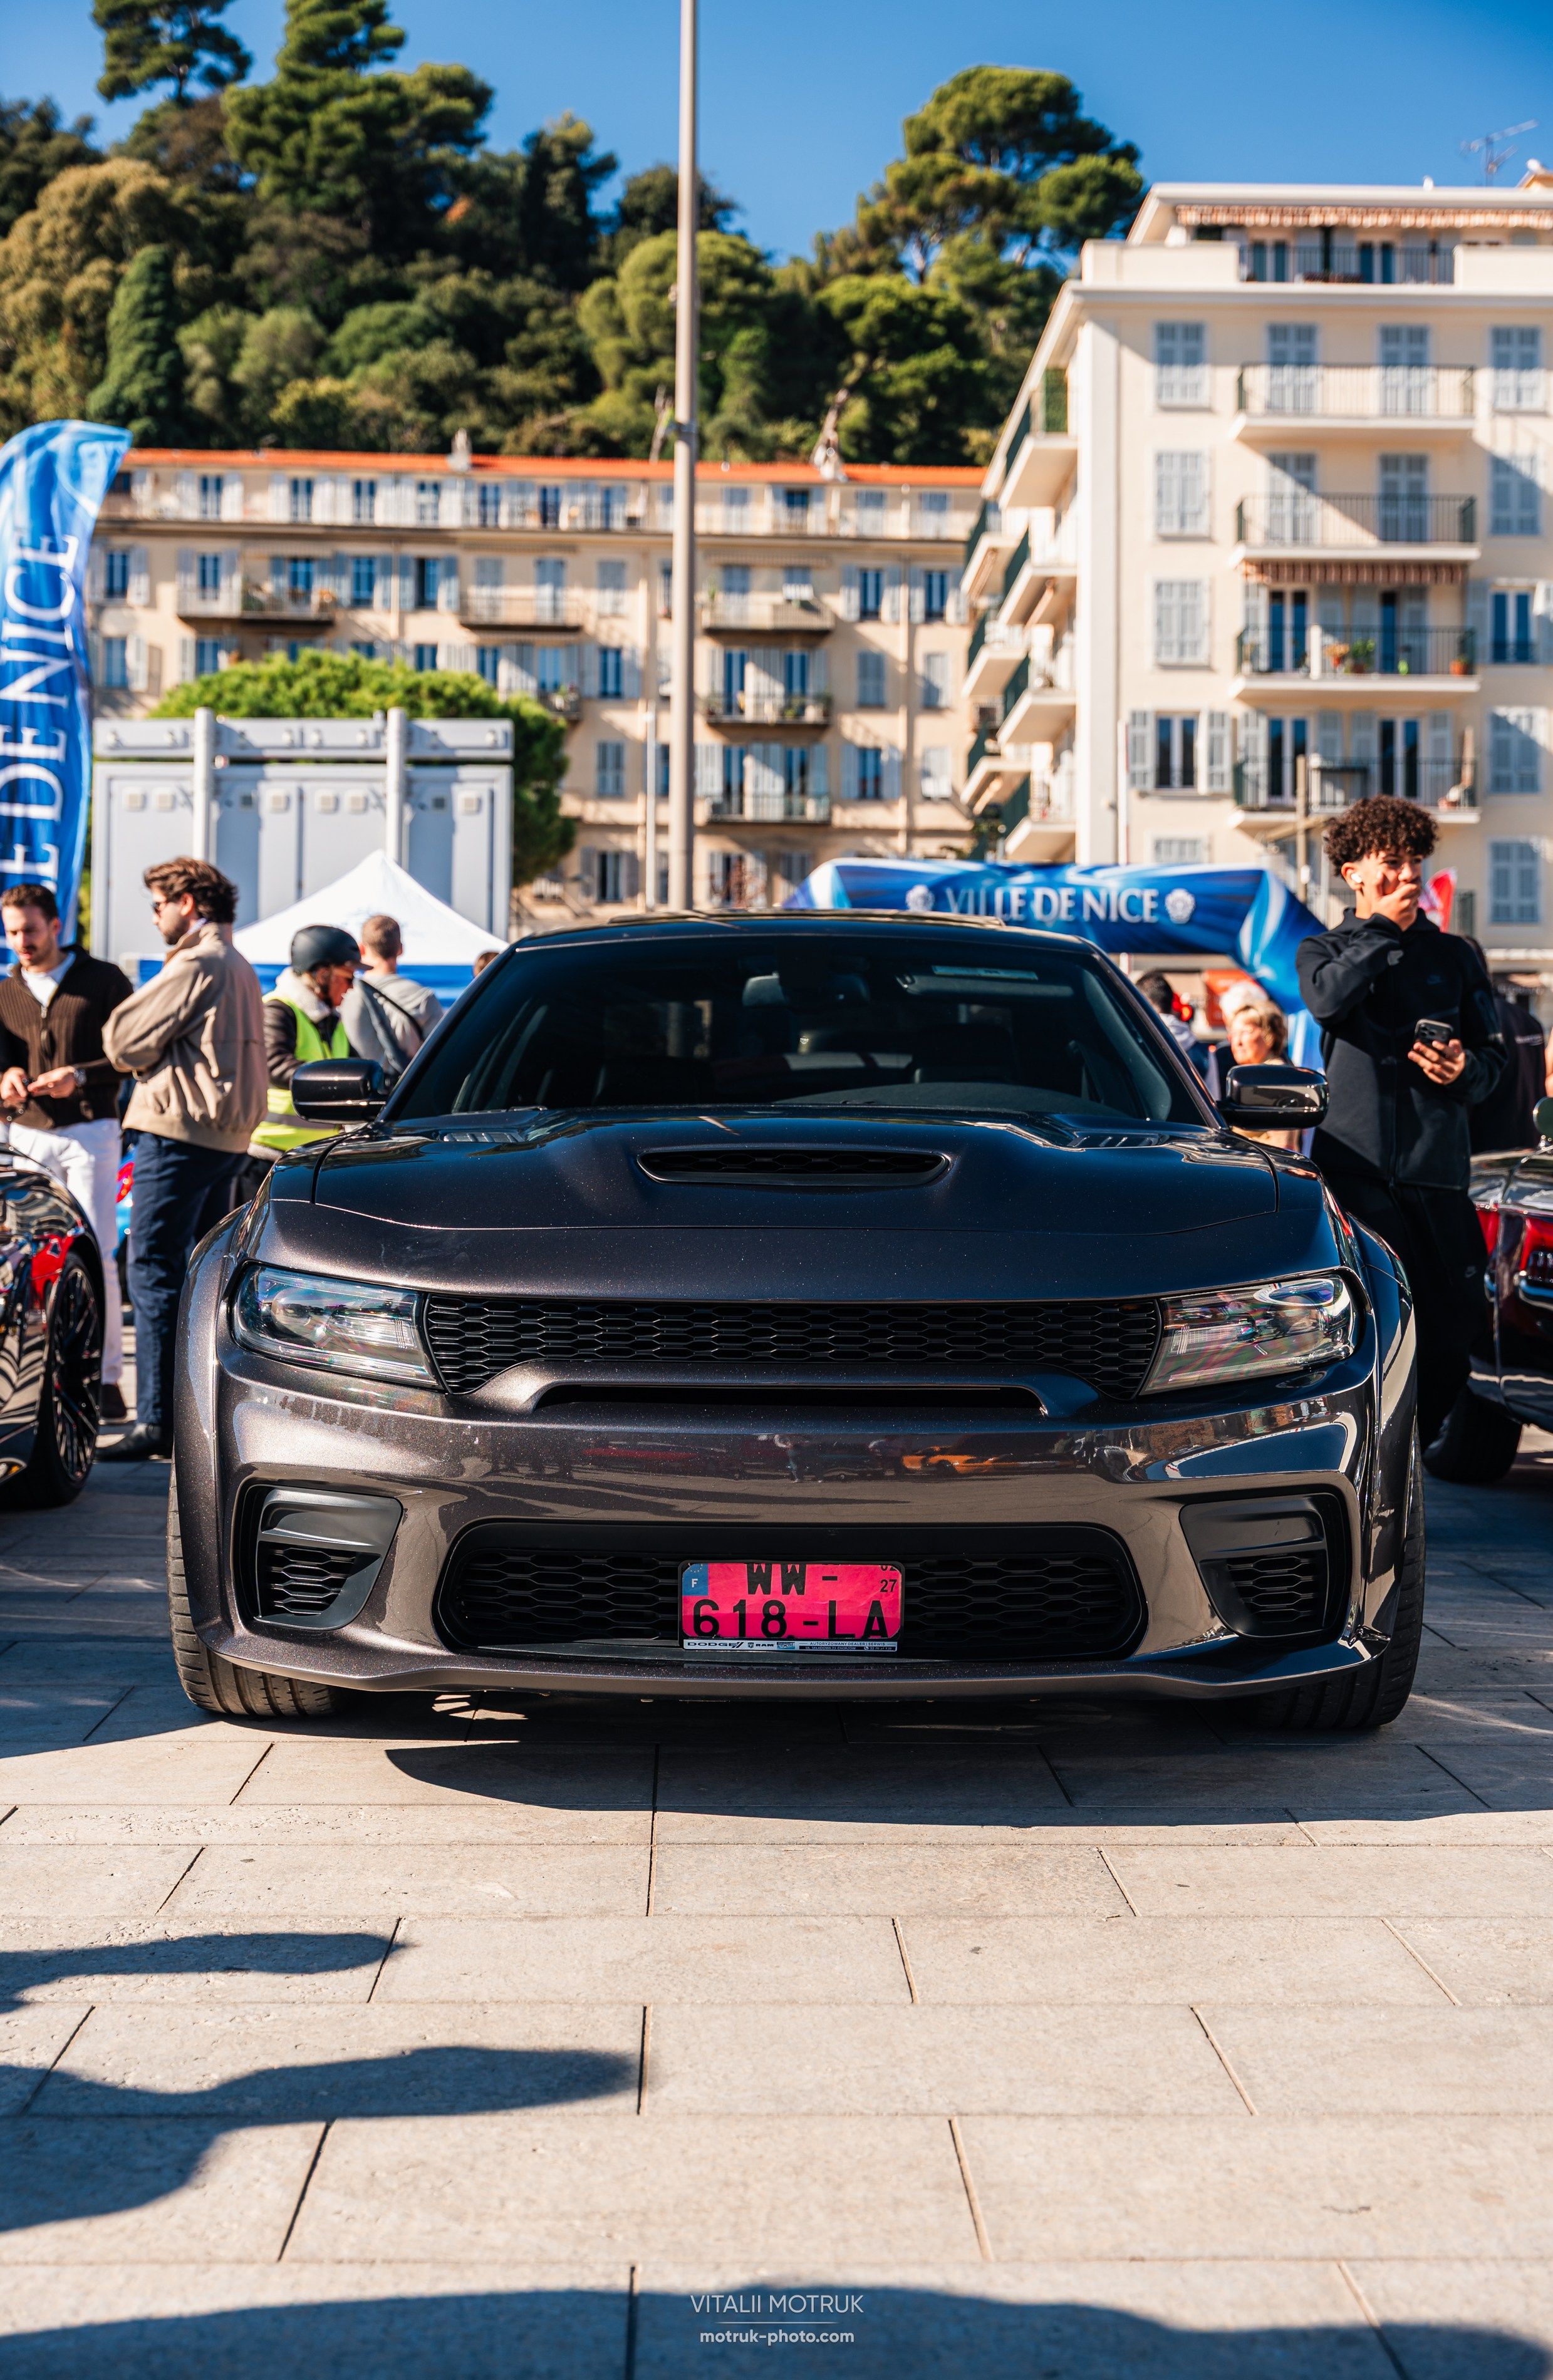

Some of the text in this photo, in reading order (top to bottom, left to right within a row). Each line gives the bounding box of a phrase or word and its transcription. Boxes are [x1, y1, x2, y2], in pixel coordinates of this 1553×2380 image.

[0, 534, 79, 709] NICE
[0, 724, 67, 824] DE
[945, 886, 1160, 923] VILLE DE NICE
[691, 1578, 699, 1588] F
[880, 1579, 897, 1593] 27
